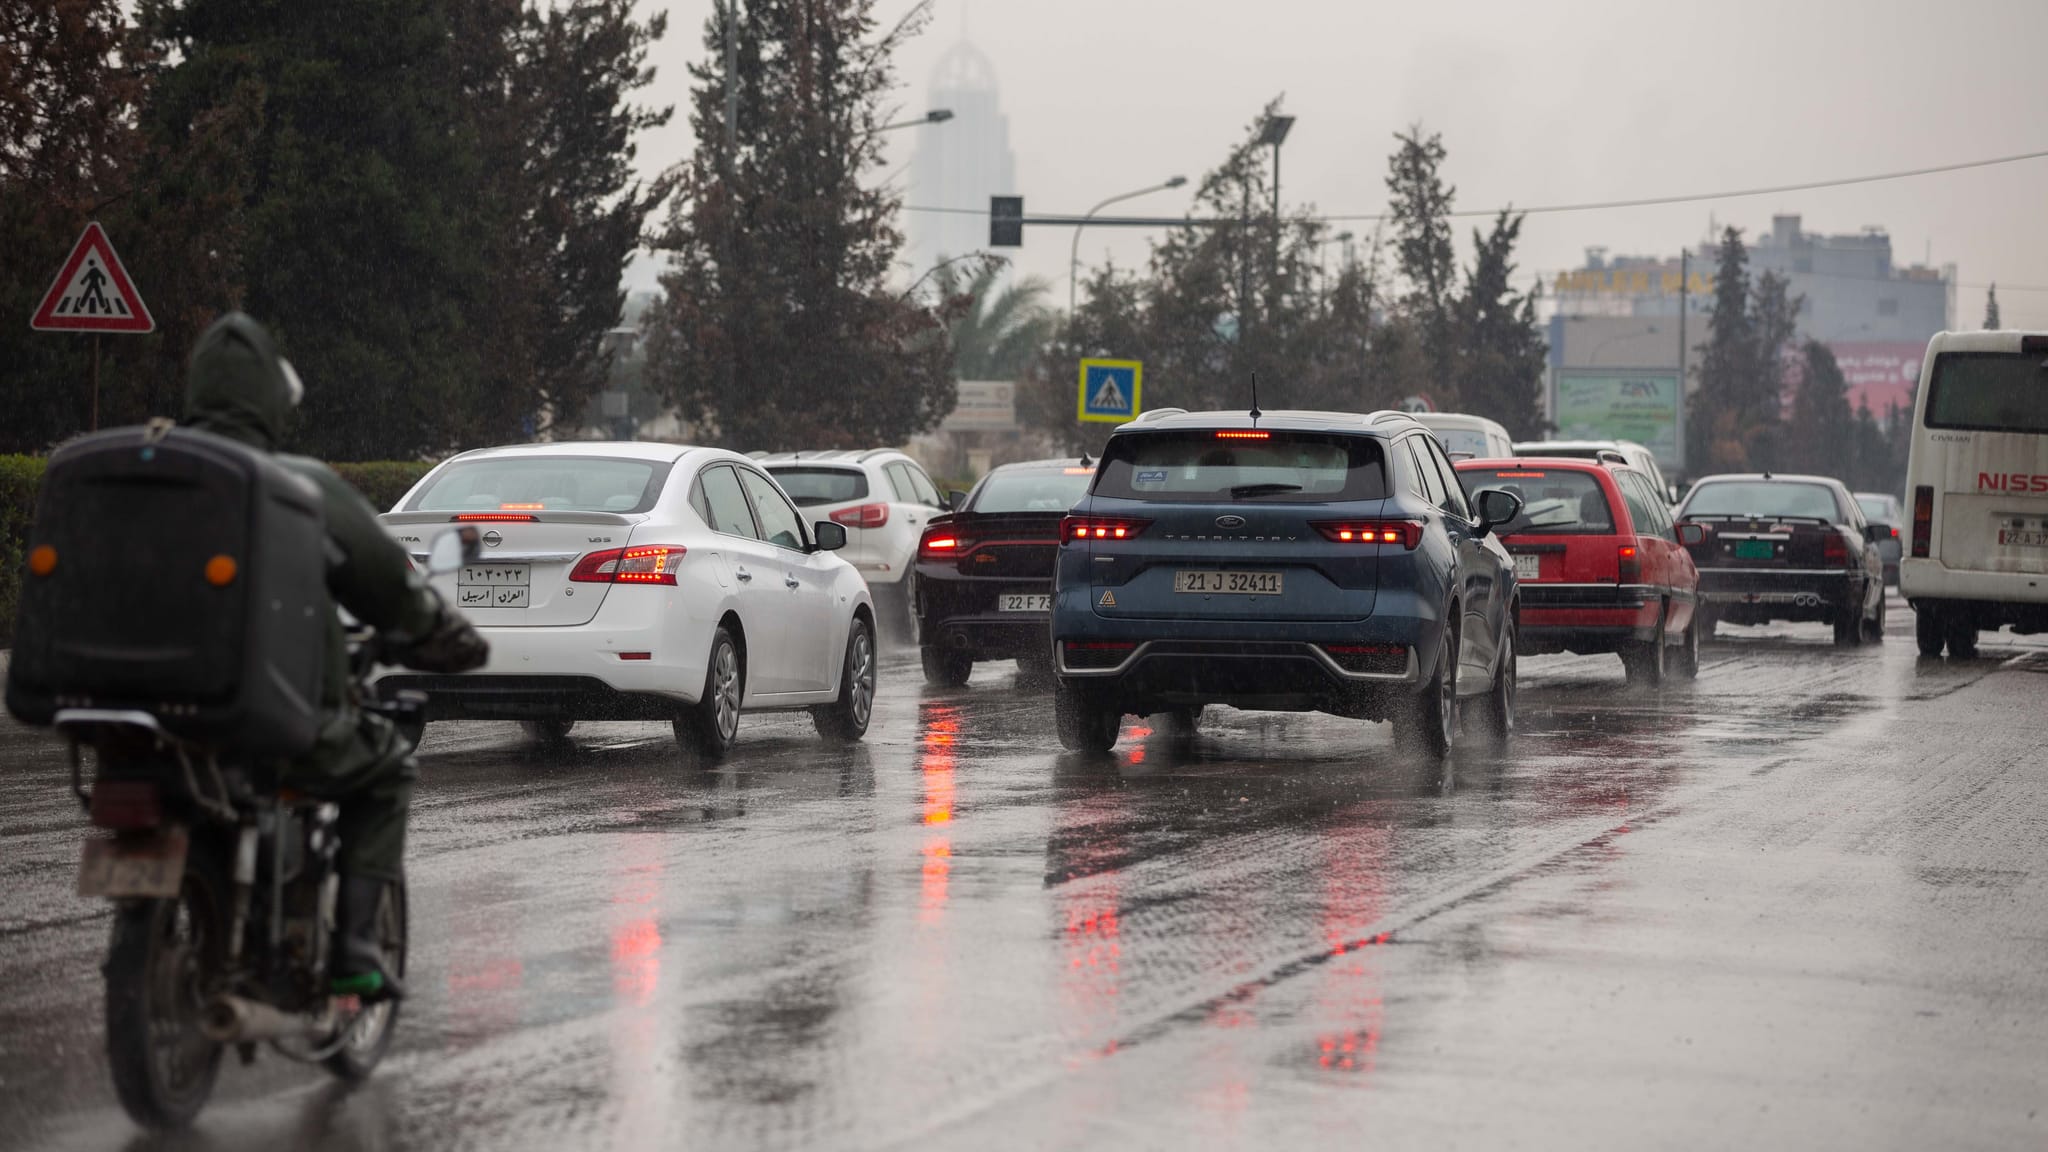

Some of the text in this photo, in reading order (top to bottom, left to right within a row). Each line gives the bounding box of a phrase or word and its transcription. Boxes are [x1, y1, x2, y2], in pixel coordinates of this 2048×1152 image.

[1978, 472, 2048, 492] NISS
[1165, 534, 1297, 542] TERRITORY
[466, 568, 522, 581] ٦٠٣٠٣٣
[1187, 573, 1206, 591] 21
[1213, 573, 1223, 591] J
[1229, 574, 1278, 592] 32411
[498, 589, 524, 603] العراق
[1008, 596, 1022, 609] 22
[1027, 596, 1034, 609] F
